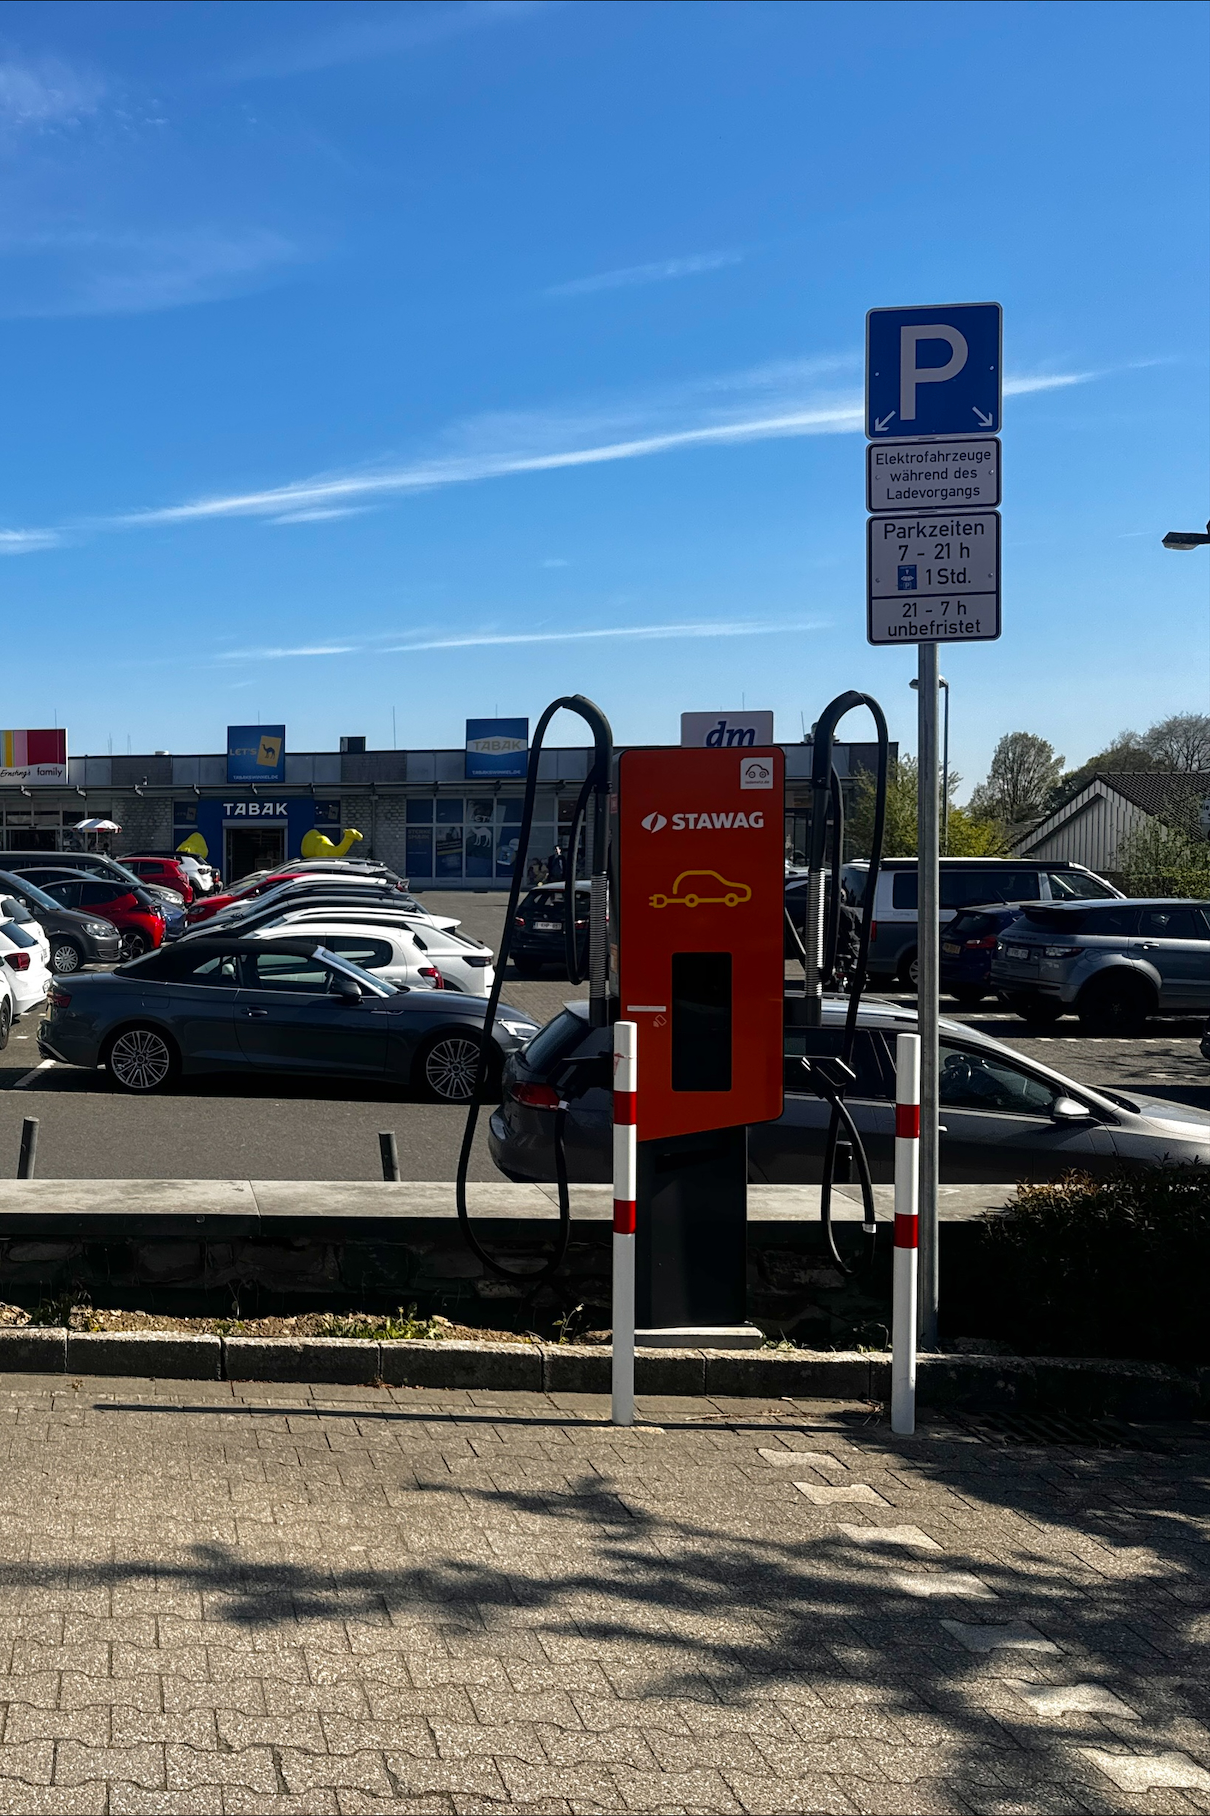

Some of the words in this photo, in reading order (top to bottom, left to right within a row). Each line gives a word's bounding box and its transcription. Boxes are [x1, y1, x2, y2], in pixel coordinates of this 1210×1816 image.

[900, 324, 969, 421] P
[876, 451, 991, 465] Elektrofahrzeuge
[890, 468, 948, 482] während
[954, 467, 978, 479] des
[887, 486, 980, 500] Ladevorgangs
[884, 520, 984, 539] Parkzeiten
[898, 545, 909, 561] 7
[934, 543, 950, 560] 21
[960, 542, 970, 559] h
[902, 603, 917, 618] 21
[941, 602, 950, 616] 7
[958, 601, 967, 615] h
[888, 620, 981, 637] unbefristet
[706, 721, 755, 747] dm
[229, 748, 256, 756] LET'S
[473, 740, 521, 751] TABAK
[37, 767, 62, 777] family
[223, 803, 288, 816] TABAK
[672, 811, 764, 831] STAWAG
